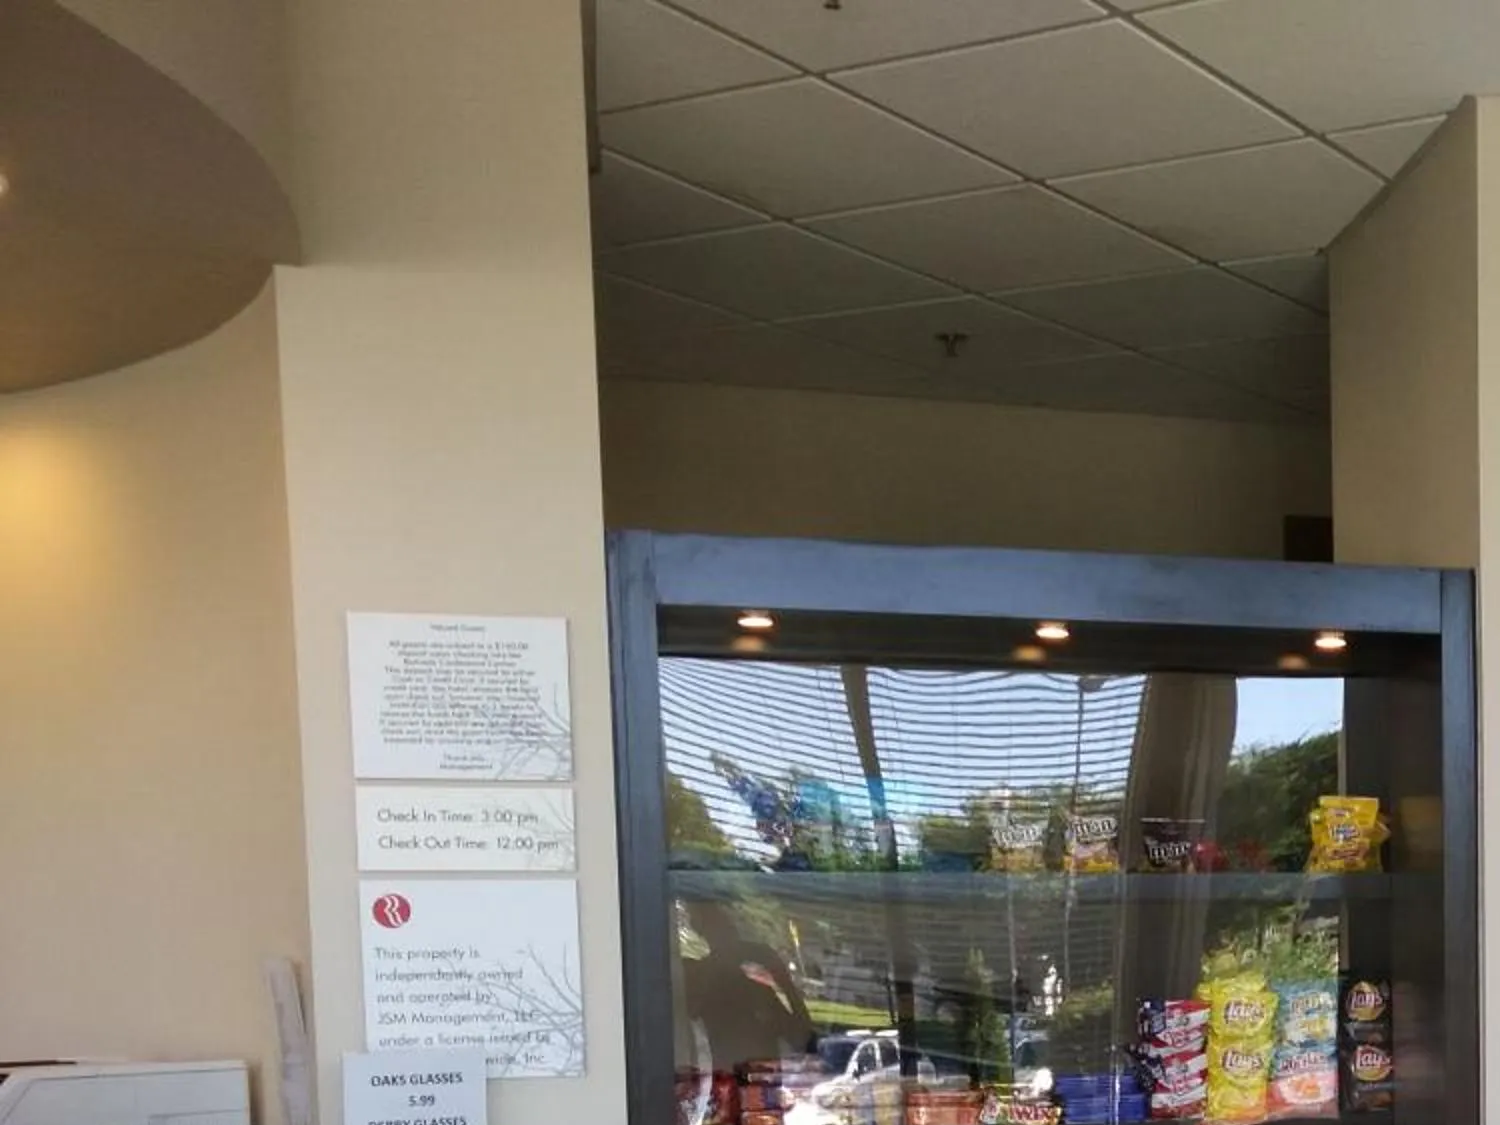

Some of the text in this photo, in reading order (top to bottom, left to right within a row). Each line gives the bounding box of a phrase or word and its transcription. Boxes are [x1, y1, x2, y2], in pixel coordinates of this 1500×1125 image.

[377, 809, 418, 823] Check
[423, 810, 437, 823] In
[518, 813, 538, 827] pm
[378, 836, 419, 850] Check
[424, 837, 451, 850] Out
[496, 836, 533, 850] 12:00
[537, 839, 559, 854] pm
[375, 946, 402, 960] This
[407, 946, 465, 963] property
[375, 967, 523, 984] independently owned
[377, 991, 405, 1004] and
[409, 991, 471, 1008] operated
[379, 1033, 420, 1047] under
[371, 1072, 463, 1088] OAKS GLASSES
[408, 1094, 435, 1107] 5.99
